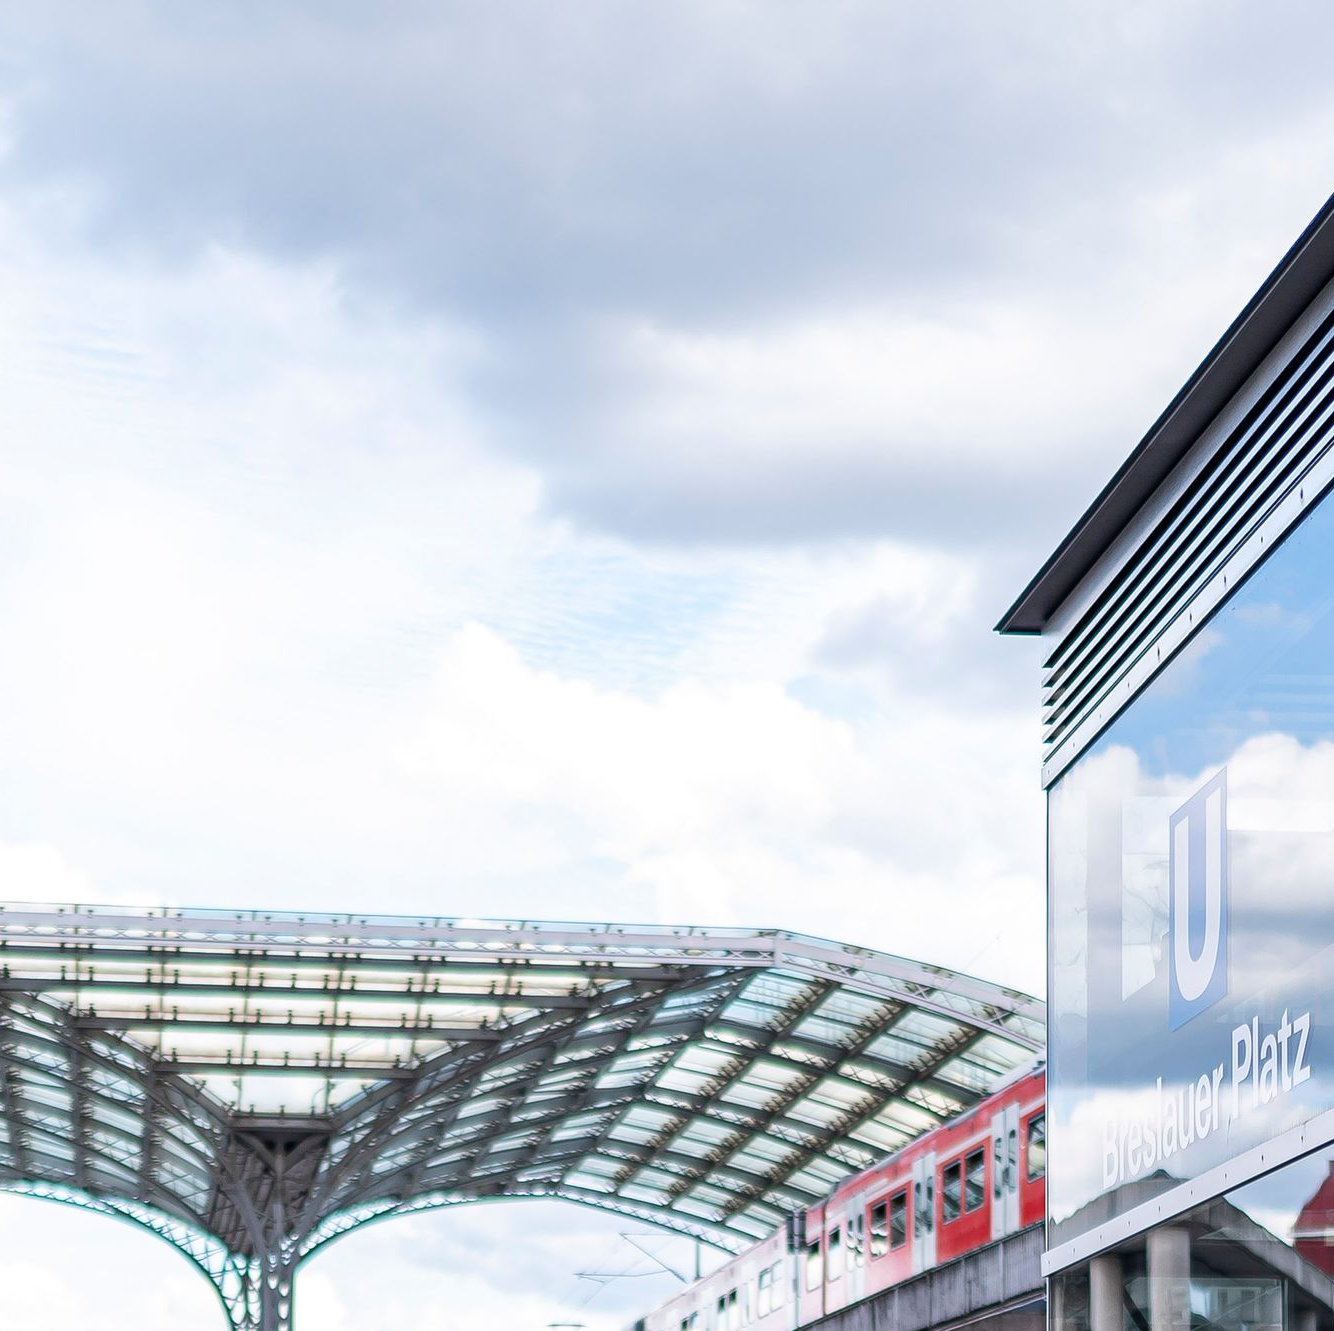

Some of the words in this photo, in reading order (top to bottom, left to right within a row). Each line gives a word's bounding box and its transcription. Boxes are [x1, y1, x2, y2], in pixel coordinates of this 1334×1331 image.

[1174, 787, 1222, 1001] U
[1102, 1063, 1224, 1190] Breslauer
[1232, 1008, 1311, 1121] Platz
